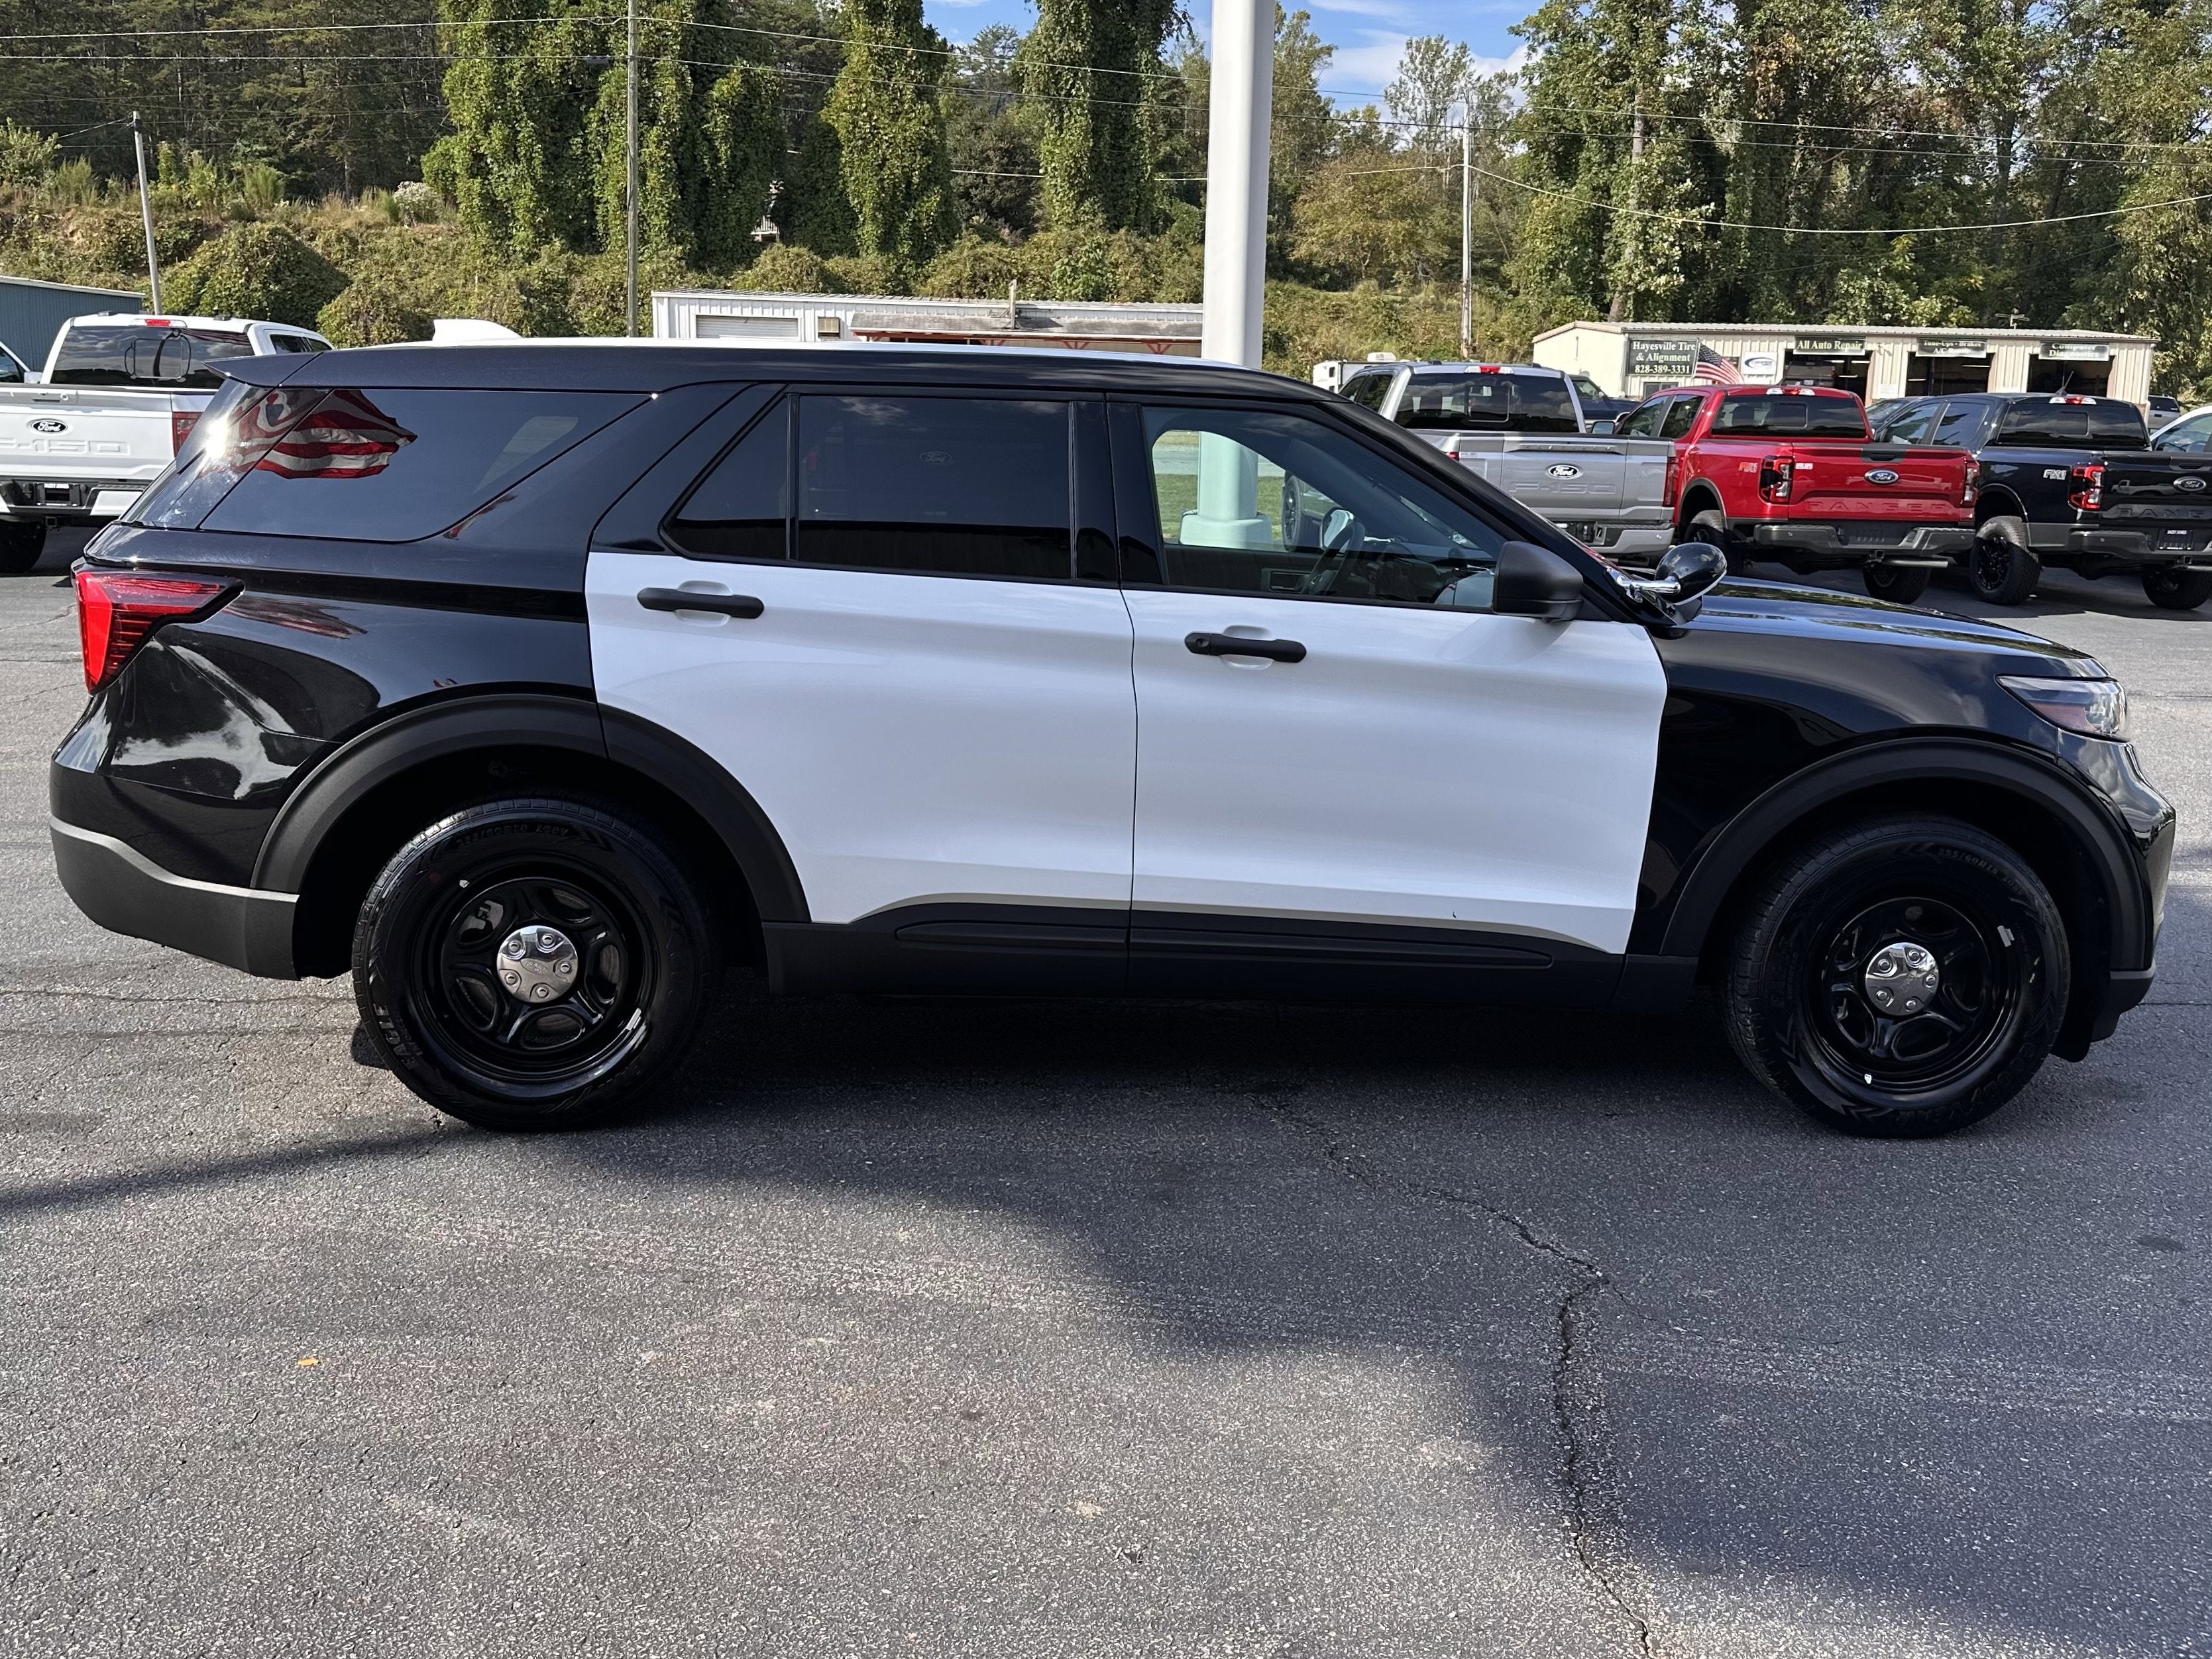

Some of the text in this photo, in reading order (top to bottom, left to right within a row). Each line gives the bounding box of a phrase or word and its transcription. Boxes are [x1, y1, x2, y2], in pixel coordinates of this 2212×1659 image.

[1632, 341, 1696, 352] Hayesville Tire
[1797, 340, 1863, 351] All Auto Repair
[1635, 352, 1690, 364] & Alignment
[1634, 364, 1690, 374] 828-389-3331
[37, 421, 62, 432] Ford
[1553, 465, 1575, 476] Ford
[1509, 481, 1616, 494] F-150
[1807, 501, 1950, 513] RANGER
[372, 1002, 422, 1071] EAGLE
